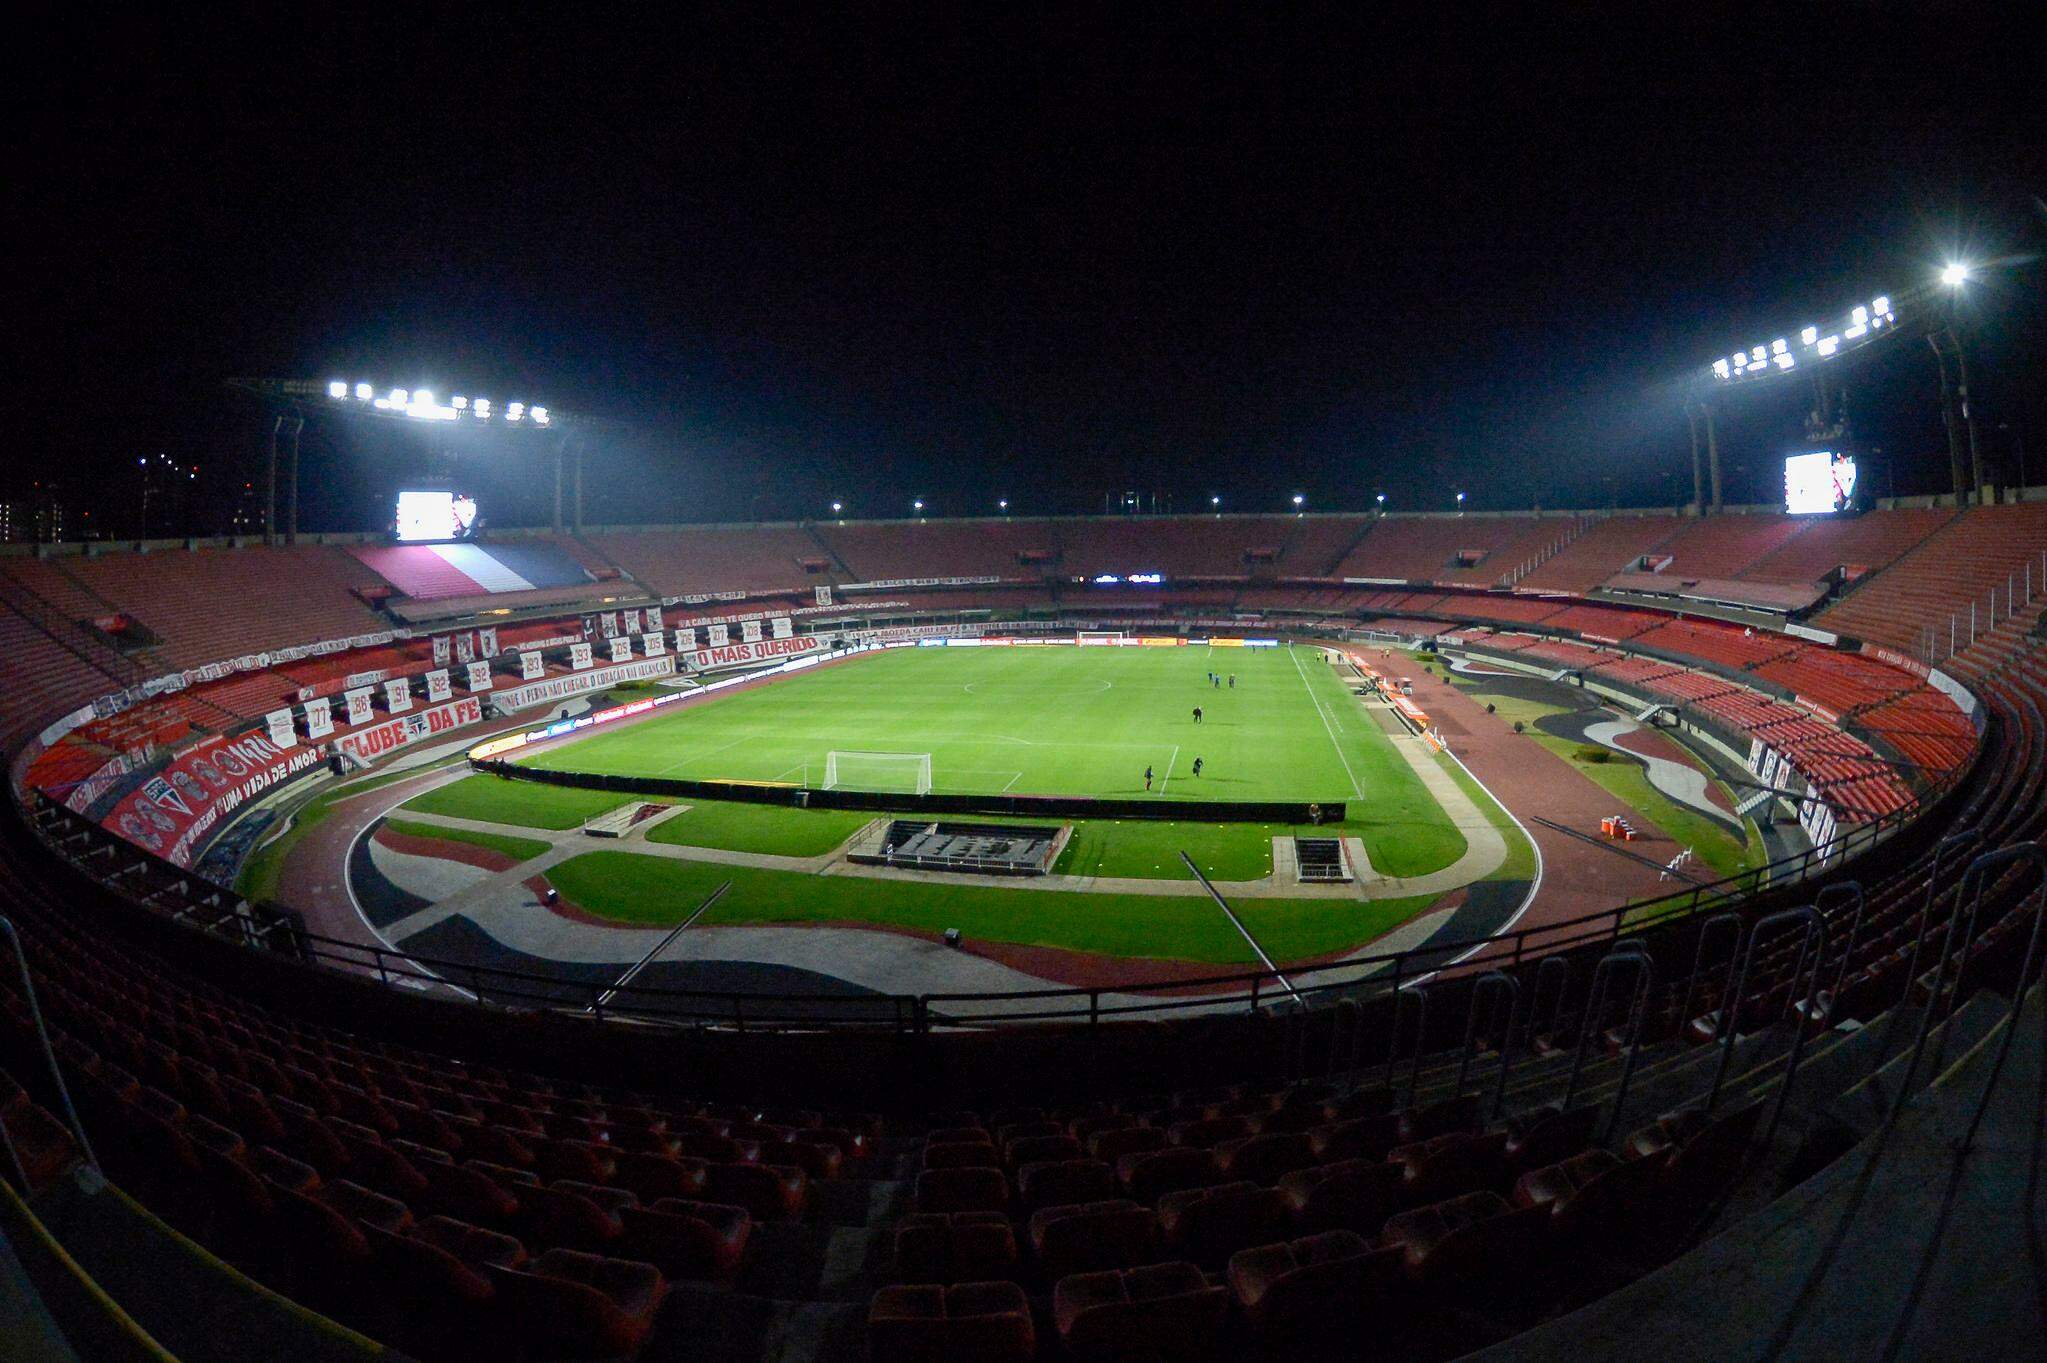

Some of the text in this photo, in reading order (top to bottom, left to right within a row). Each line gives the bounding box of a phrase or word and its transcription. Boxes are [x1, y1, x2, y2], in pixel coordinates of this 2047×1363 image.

[880, 628, 911, 637] MOEDA
[697, 652, 709, 667] O
[711, 645, 752, 665] MAIS
[755, 637, 818, 658] QUERIDO
[526, 684, 548, 702] PERNA
[342, 720, 407, 758] CLUBE
[427, 707, 454, 733] DA
[222, 748, 317, 813] UMA VIDA DE AMOR
